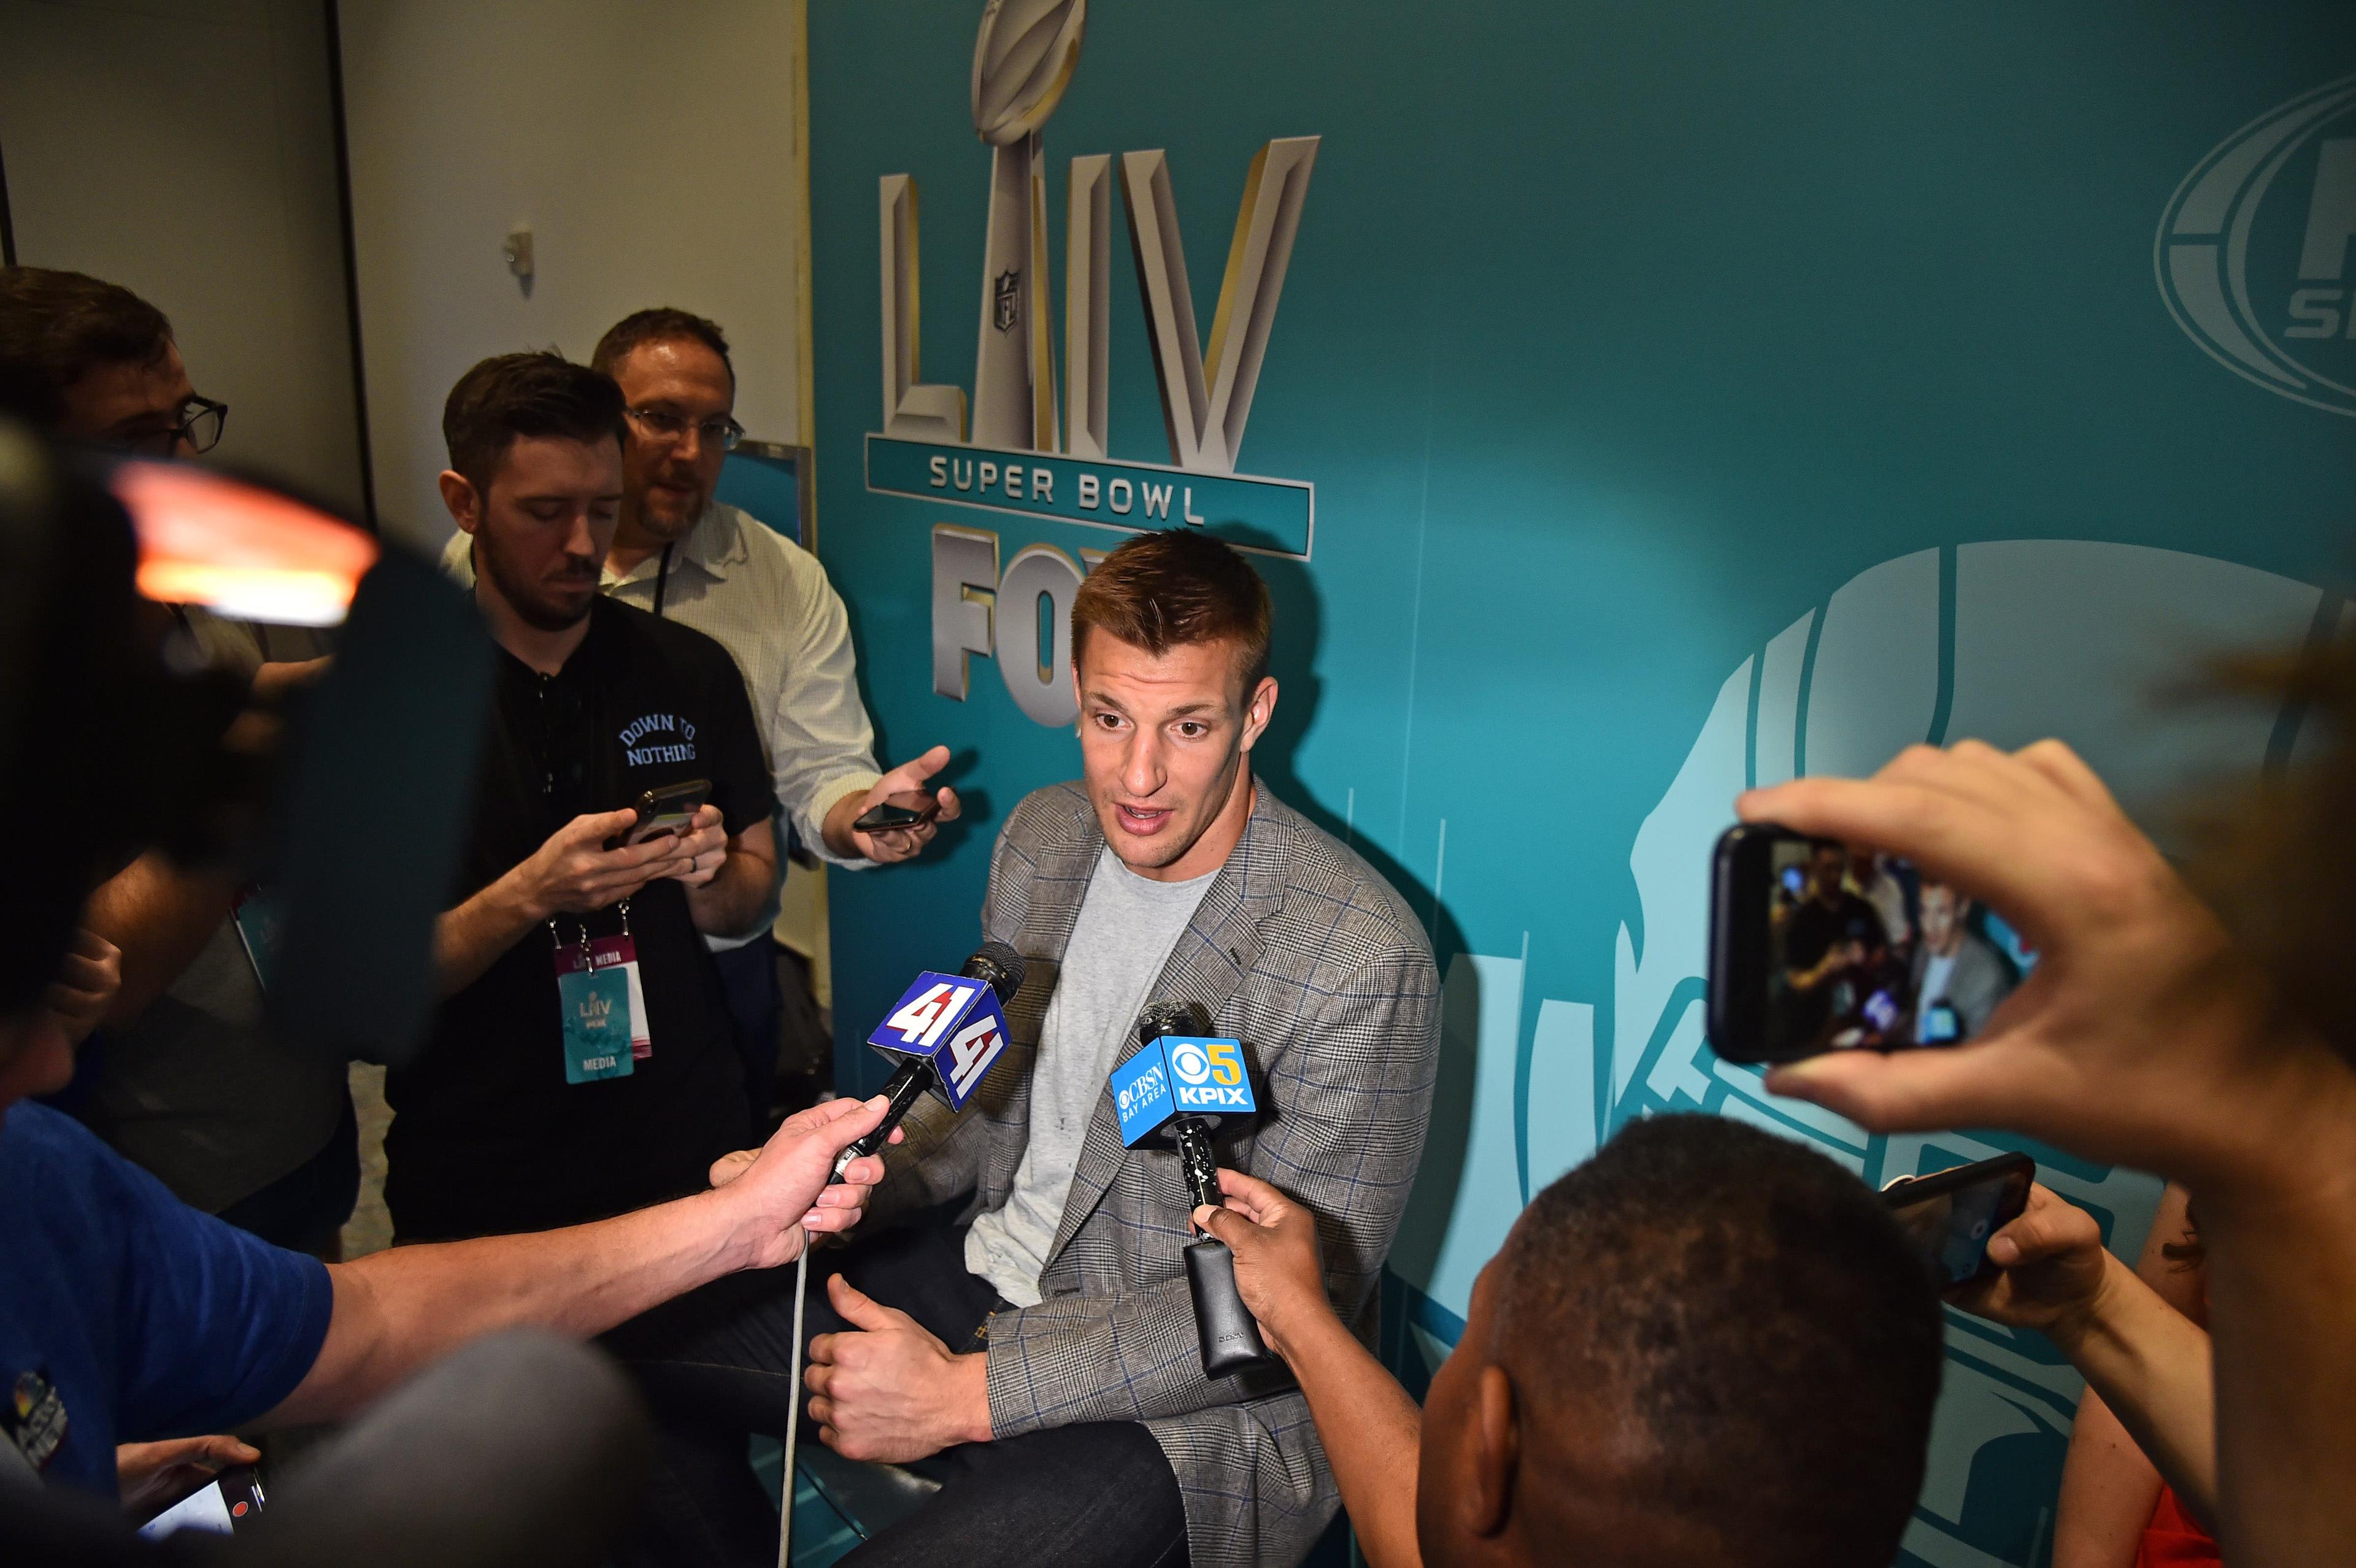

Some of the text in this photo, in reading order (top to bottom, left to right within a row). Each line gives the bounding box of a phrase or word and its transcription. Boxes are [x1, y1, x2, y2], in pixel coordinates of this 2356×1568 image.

[930, 455, 1205, 526] SUPER BOWL
[931, 522, 1108, 729] FO
[619, 713, 696, 747] DOWN TO
[626, 742, 696, 767] NOTHING
[595, 951, 622, 967] MEDIA
[886, 982, 976, 1047] 41
[583, 1055, 617, 1071] MEDIA
[949, 1014, 1004, 1101] 41
[1206, 1044, 1242, 1086] 5
[1129, 1062, 1164, 1102] CBSN
[1179, 1087, 1249, 1105] KPIX
[1122, 1083, 1166, 1123] BAY AREA
